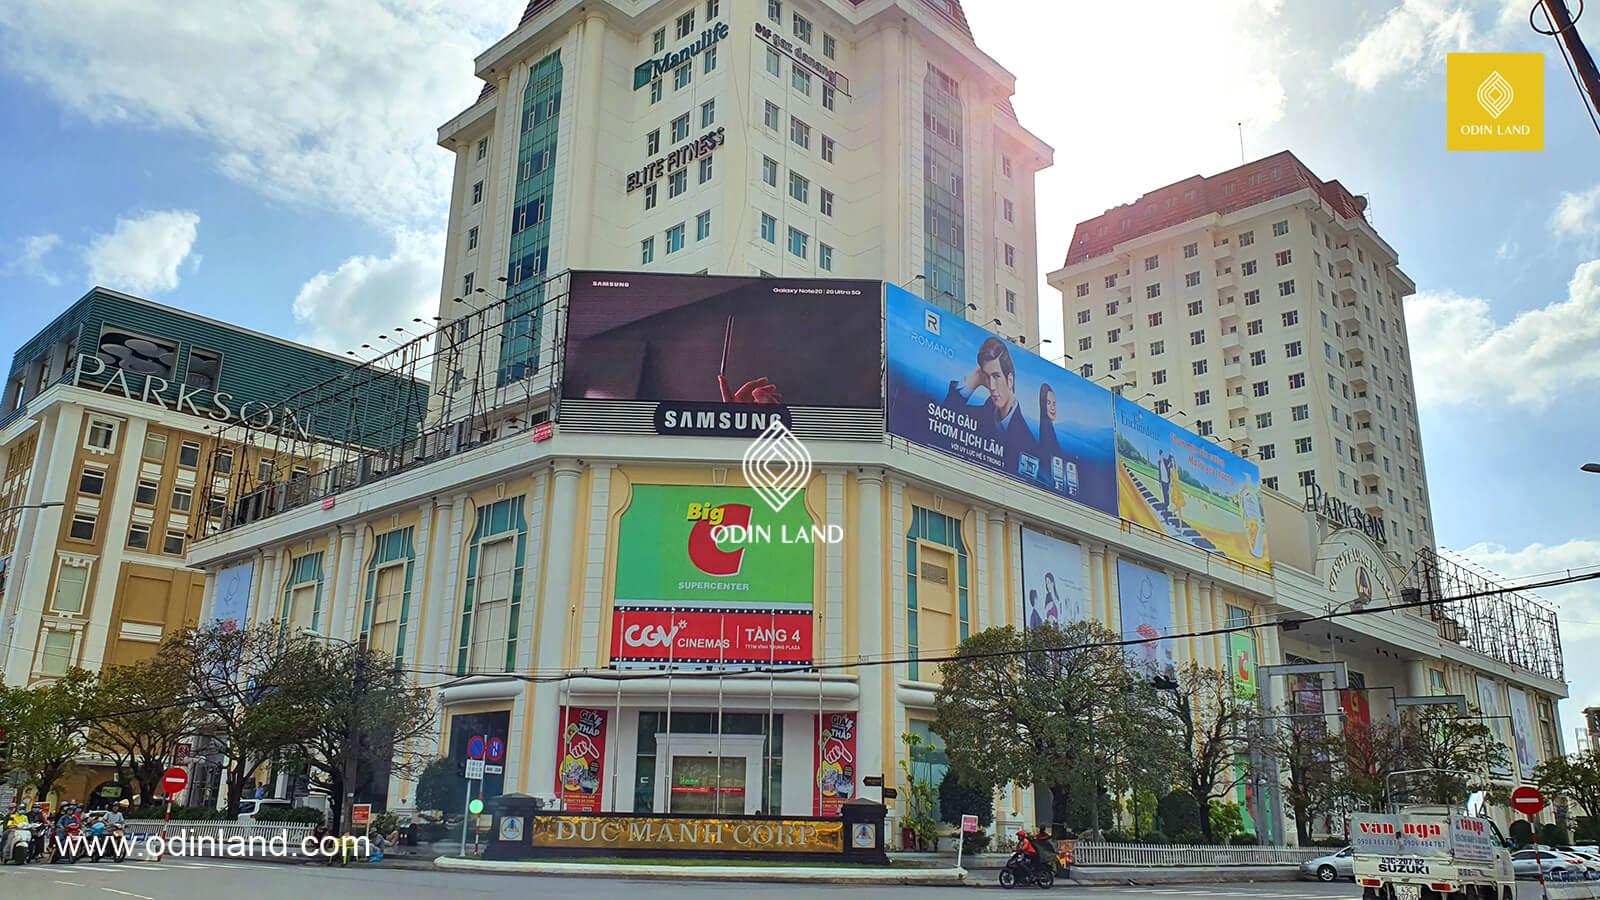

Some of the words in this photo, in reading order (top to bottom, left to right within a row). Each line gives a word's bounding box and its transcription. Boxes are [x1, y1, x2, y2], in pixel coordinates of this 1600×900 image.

[653, 22, 729, 79] Manulife
[626, 158, 665, 193] ELITE
[667, 126, 725, 172] FITNESS
[592, 280, 629, 288] SAMSUNG
[772, 287, 798, 295] Galaxy
[798, 288, 823, 296] Note20
[911, 332, 954, 359] ROMANO
[73, 353, 311, 440] PARKSON
[664, 410, 782, 431] SAMSUNG
[927, 402, 956, 423] SẠCH
[928, 417, 958, 440] THƠM
[959, 430, 982, 448] LỊCH
[983, 438, 1004, 457] LÃM
[687, 502, 725, 526] Big
[1305, 483, 1387, 545] PARKSON
[678, 582, 749, 591] SUPERCENTER
[624, 623, 680, 648] CGV
[677, 637, 730, 649] CINEMAS
[791, 629, 800, 642] 4
[555, 820, 619, 842] DUC
[627, 822, 723, 844] MANH
[732, 824, 817, 846] CORP
[1403, 823, 1441, 839] nga
[1378, 863, 1430, 875] SUZUKI
